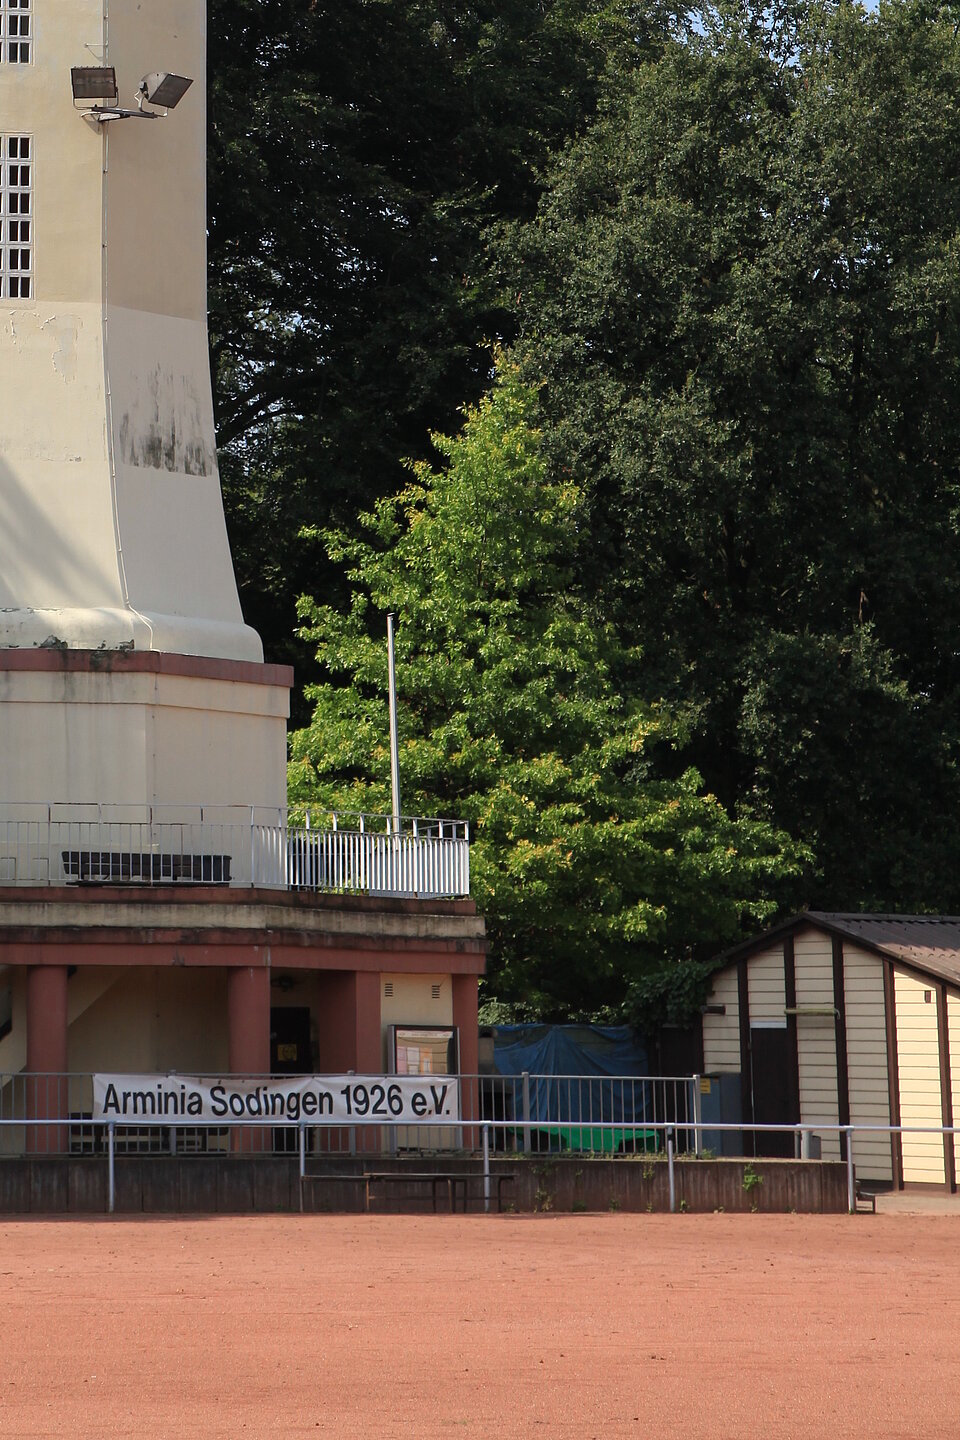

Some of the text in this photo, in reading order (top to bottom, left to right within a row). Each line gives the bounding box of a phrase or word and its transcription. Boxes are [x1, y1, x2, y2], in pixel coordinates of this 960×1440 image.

[103, 1084, 450, 1120] Arminia Sodingen 1926 e.V.
